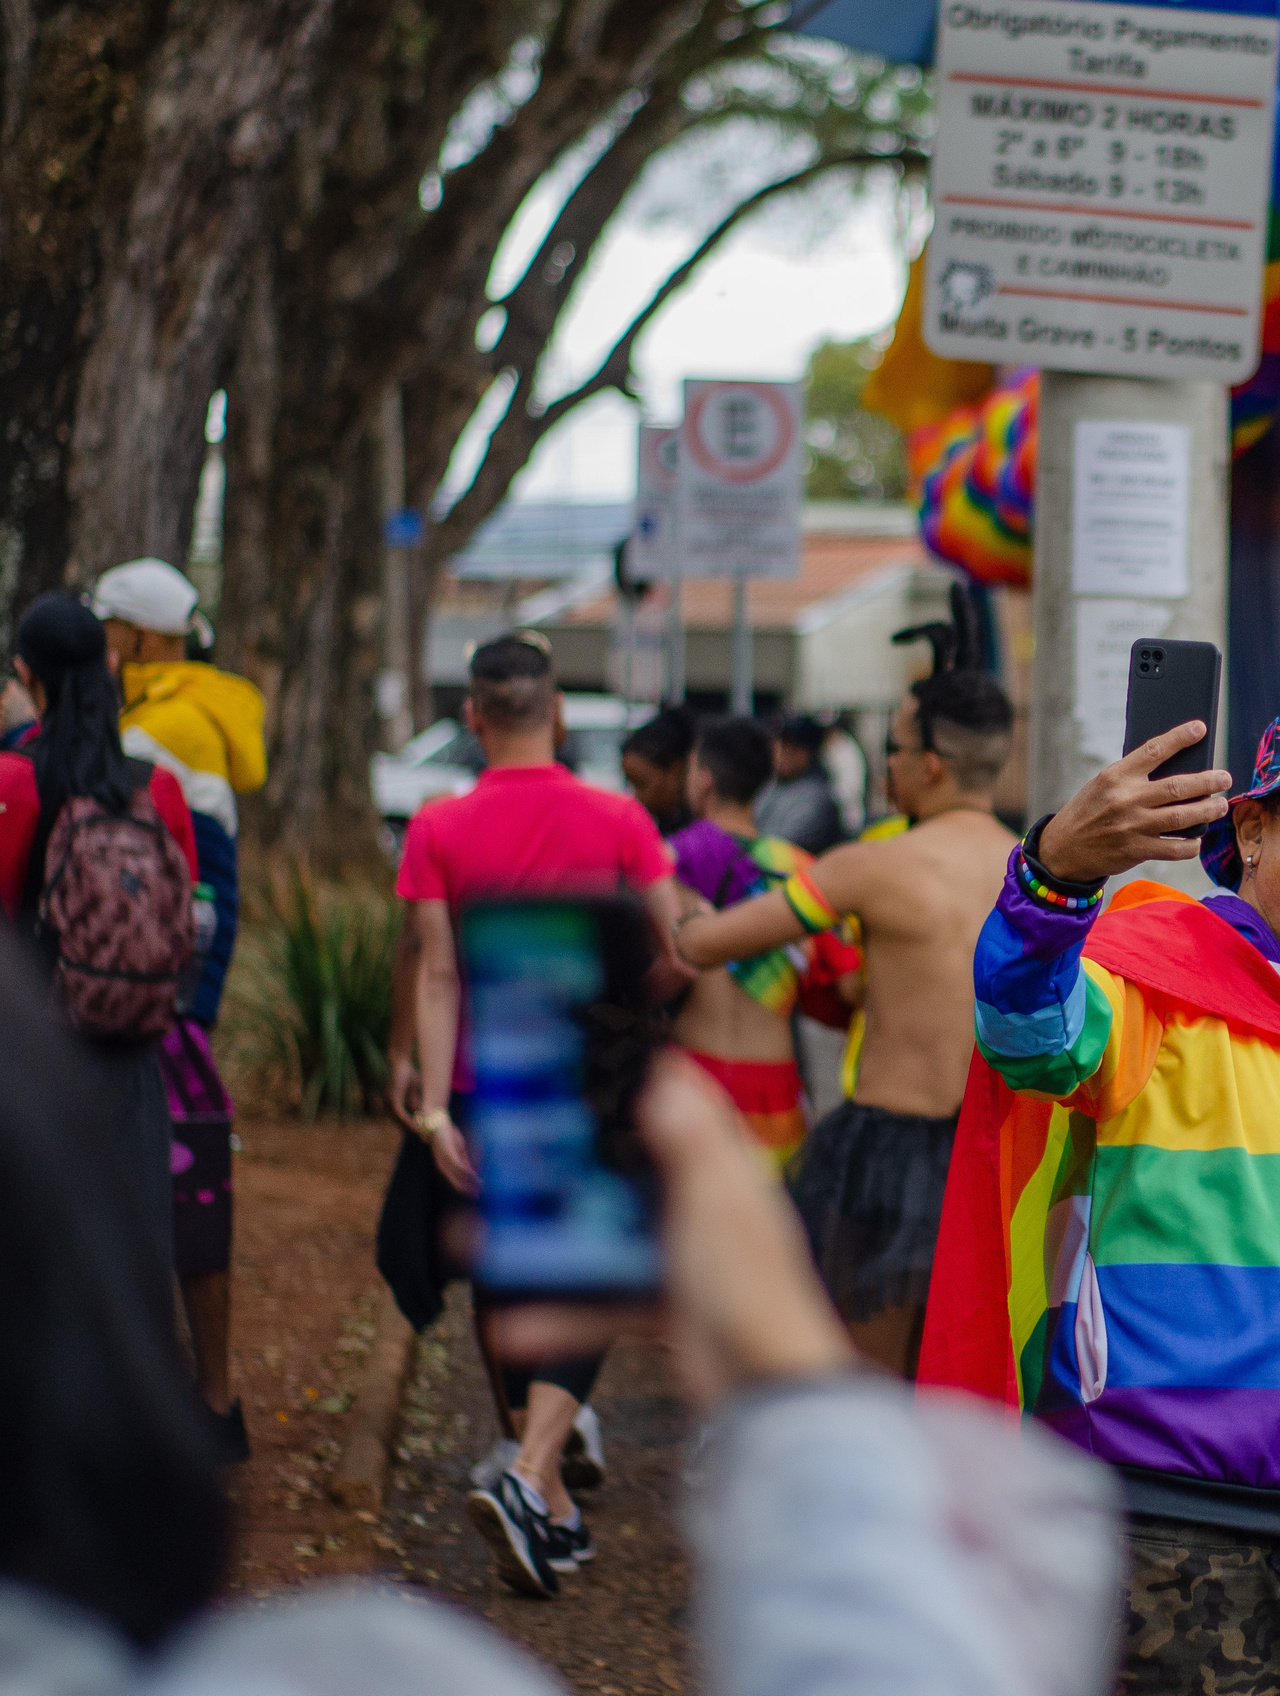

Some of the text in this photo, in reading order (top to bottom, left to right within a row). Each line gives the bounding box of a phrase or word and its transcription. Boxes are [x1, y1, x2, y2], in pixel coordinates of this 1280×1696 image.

[950, 4, 1272, 56] Obrigatório Pagamento
[1069, 47, 1147, 78] Tarifa
[971, 93, 1236, 141] MÁXIMO 2 HORAS
[992, 163, 1099, 196] Sábado
[950, 217, 1063, 247] PROIBIDO
[1016, 254, 1030, 276] E
[1018, 316, 1094, 349] Grave
[1123, 326, 1137, 352] 5
[1146, 328, 1241, 362] Pontos
